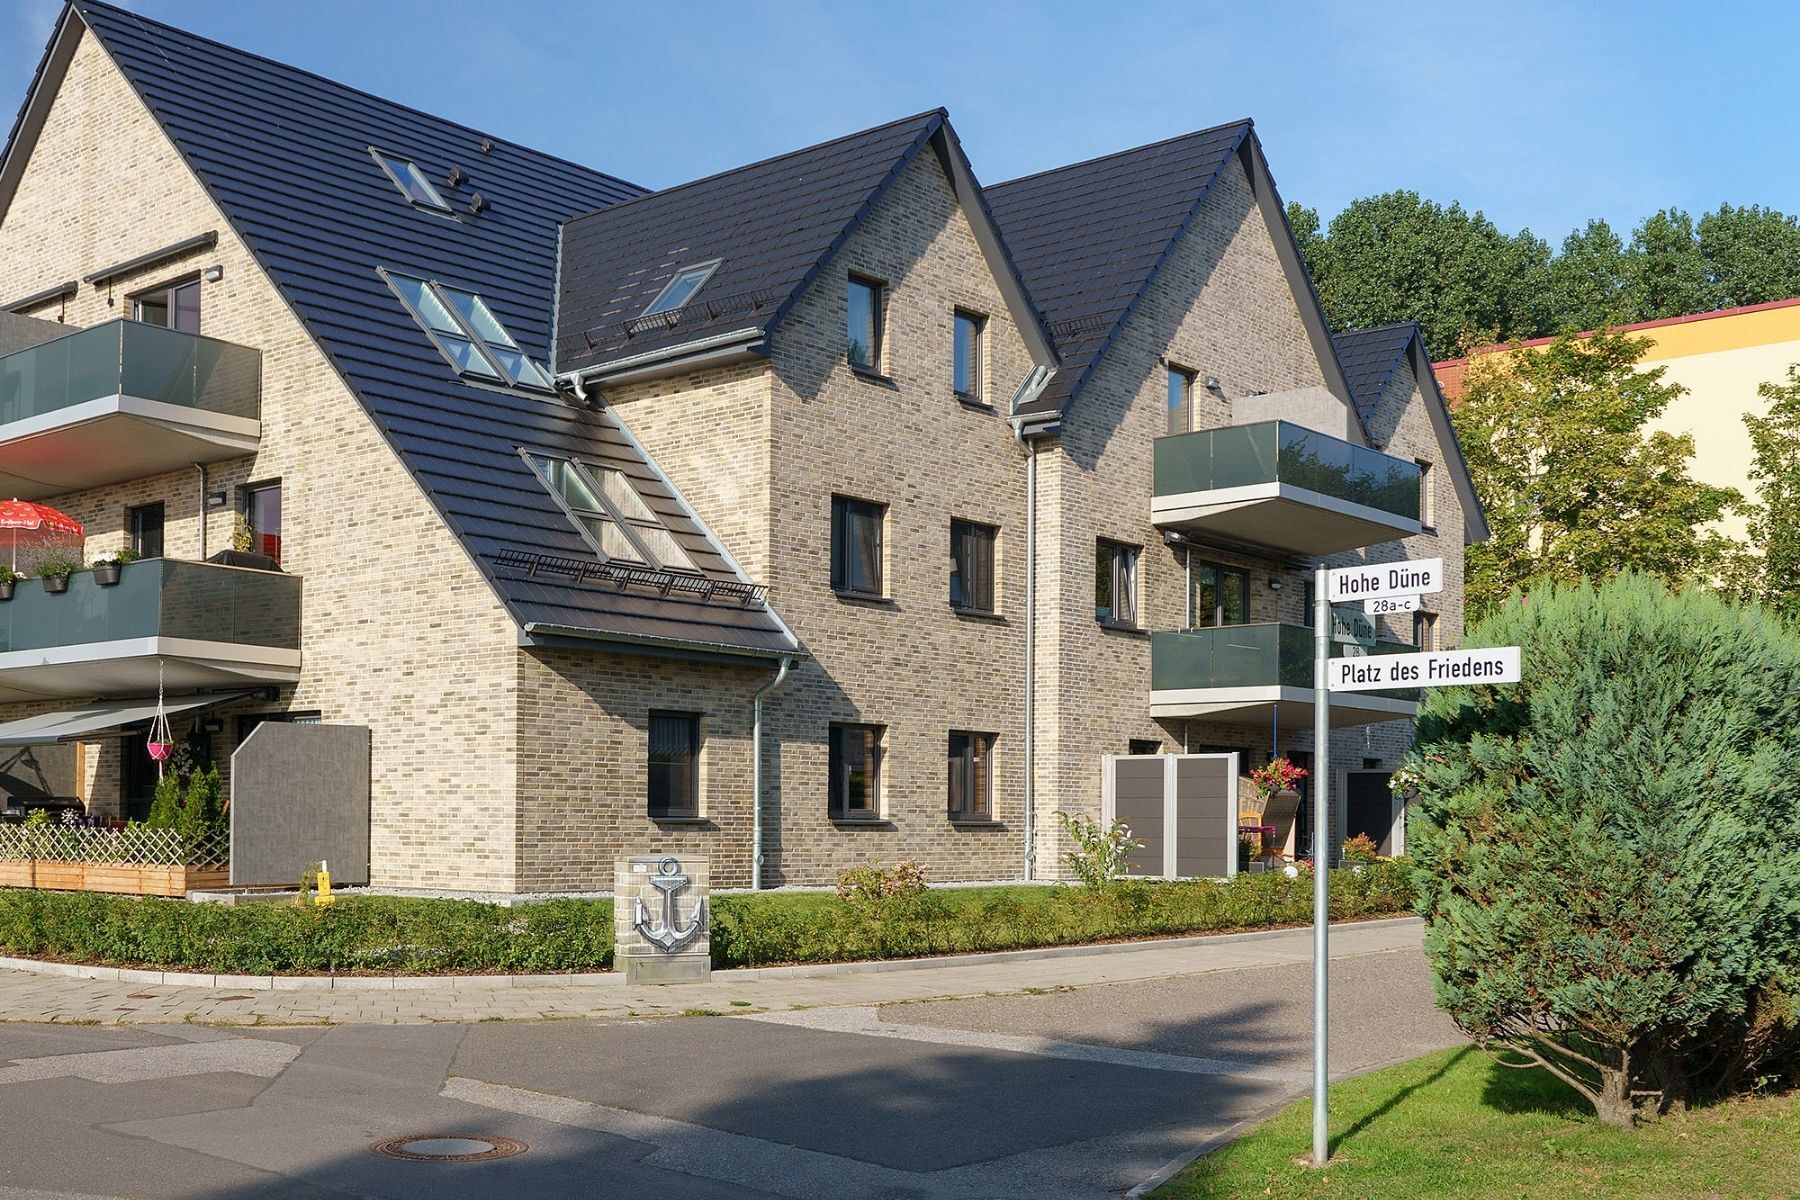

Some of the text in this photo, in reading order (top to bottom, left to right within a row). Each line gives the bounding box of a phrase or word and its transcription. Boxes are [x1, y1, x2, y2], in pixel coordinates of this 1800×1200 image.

[1339, 568, 1430, 595] Hohe Düne
[1373, 600, 1411, 612] 28a-c
[1332, 616, 1372, 639] Hohe Düne
[1352, 646, 1360, 657] 28
[1341, 657, 1504, 684] Platz des Friedens
